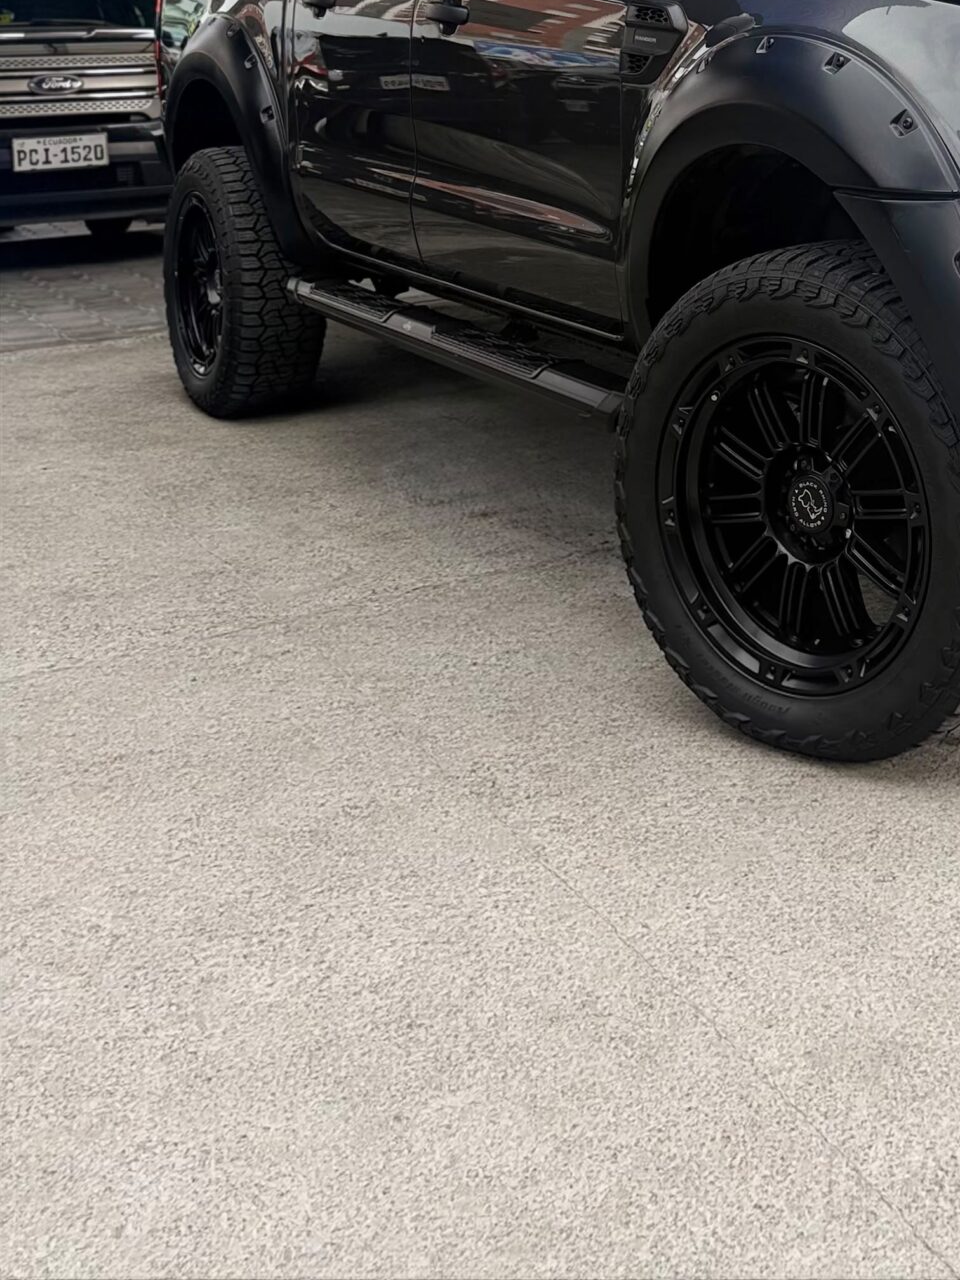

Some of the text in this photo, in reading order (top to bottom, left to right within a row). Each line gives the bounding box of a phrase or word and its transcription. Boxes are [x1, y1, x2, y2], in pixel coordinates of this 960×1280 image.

[41, 77, 82, 89] Ford
[42, 137, 78, 146] ECUADOR
[16, 144, 105, 167] PCI-1520
